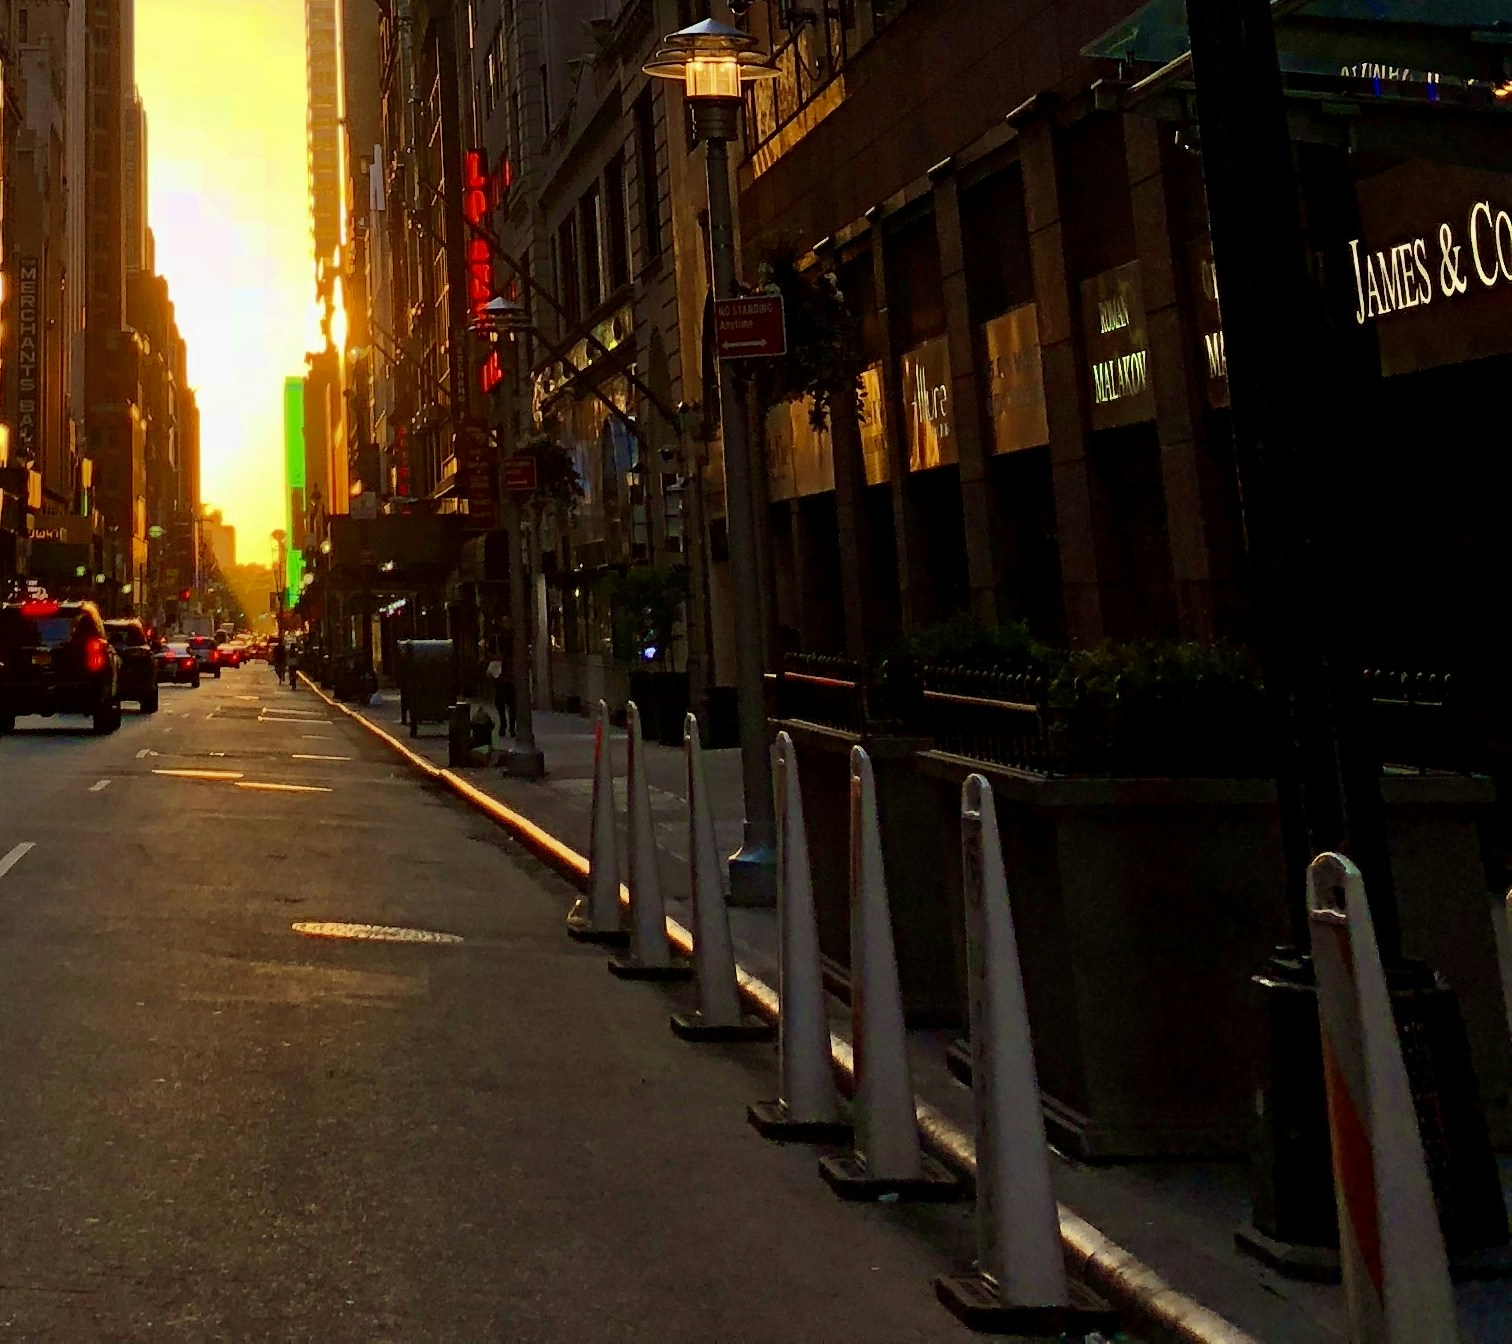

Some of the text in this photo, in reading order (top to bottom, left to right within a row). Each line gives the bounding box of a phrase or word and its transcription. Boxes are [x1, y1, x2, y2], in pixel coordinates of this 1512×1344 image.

[718, 302, 773, 316] NO STANDING
[1349, 238, 1432, 324] JAMES
[1439, 222, 1467, 297] &
[20, 267, 36, 391] MERCHANTS
[1093, 350, 1146, 403] MALAKOV
